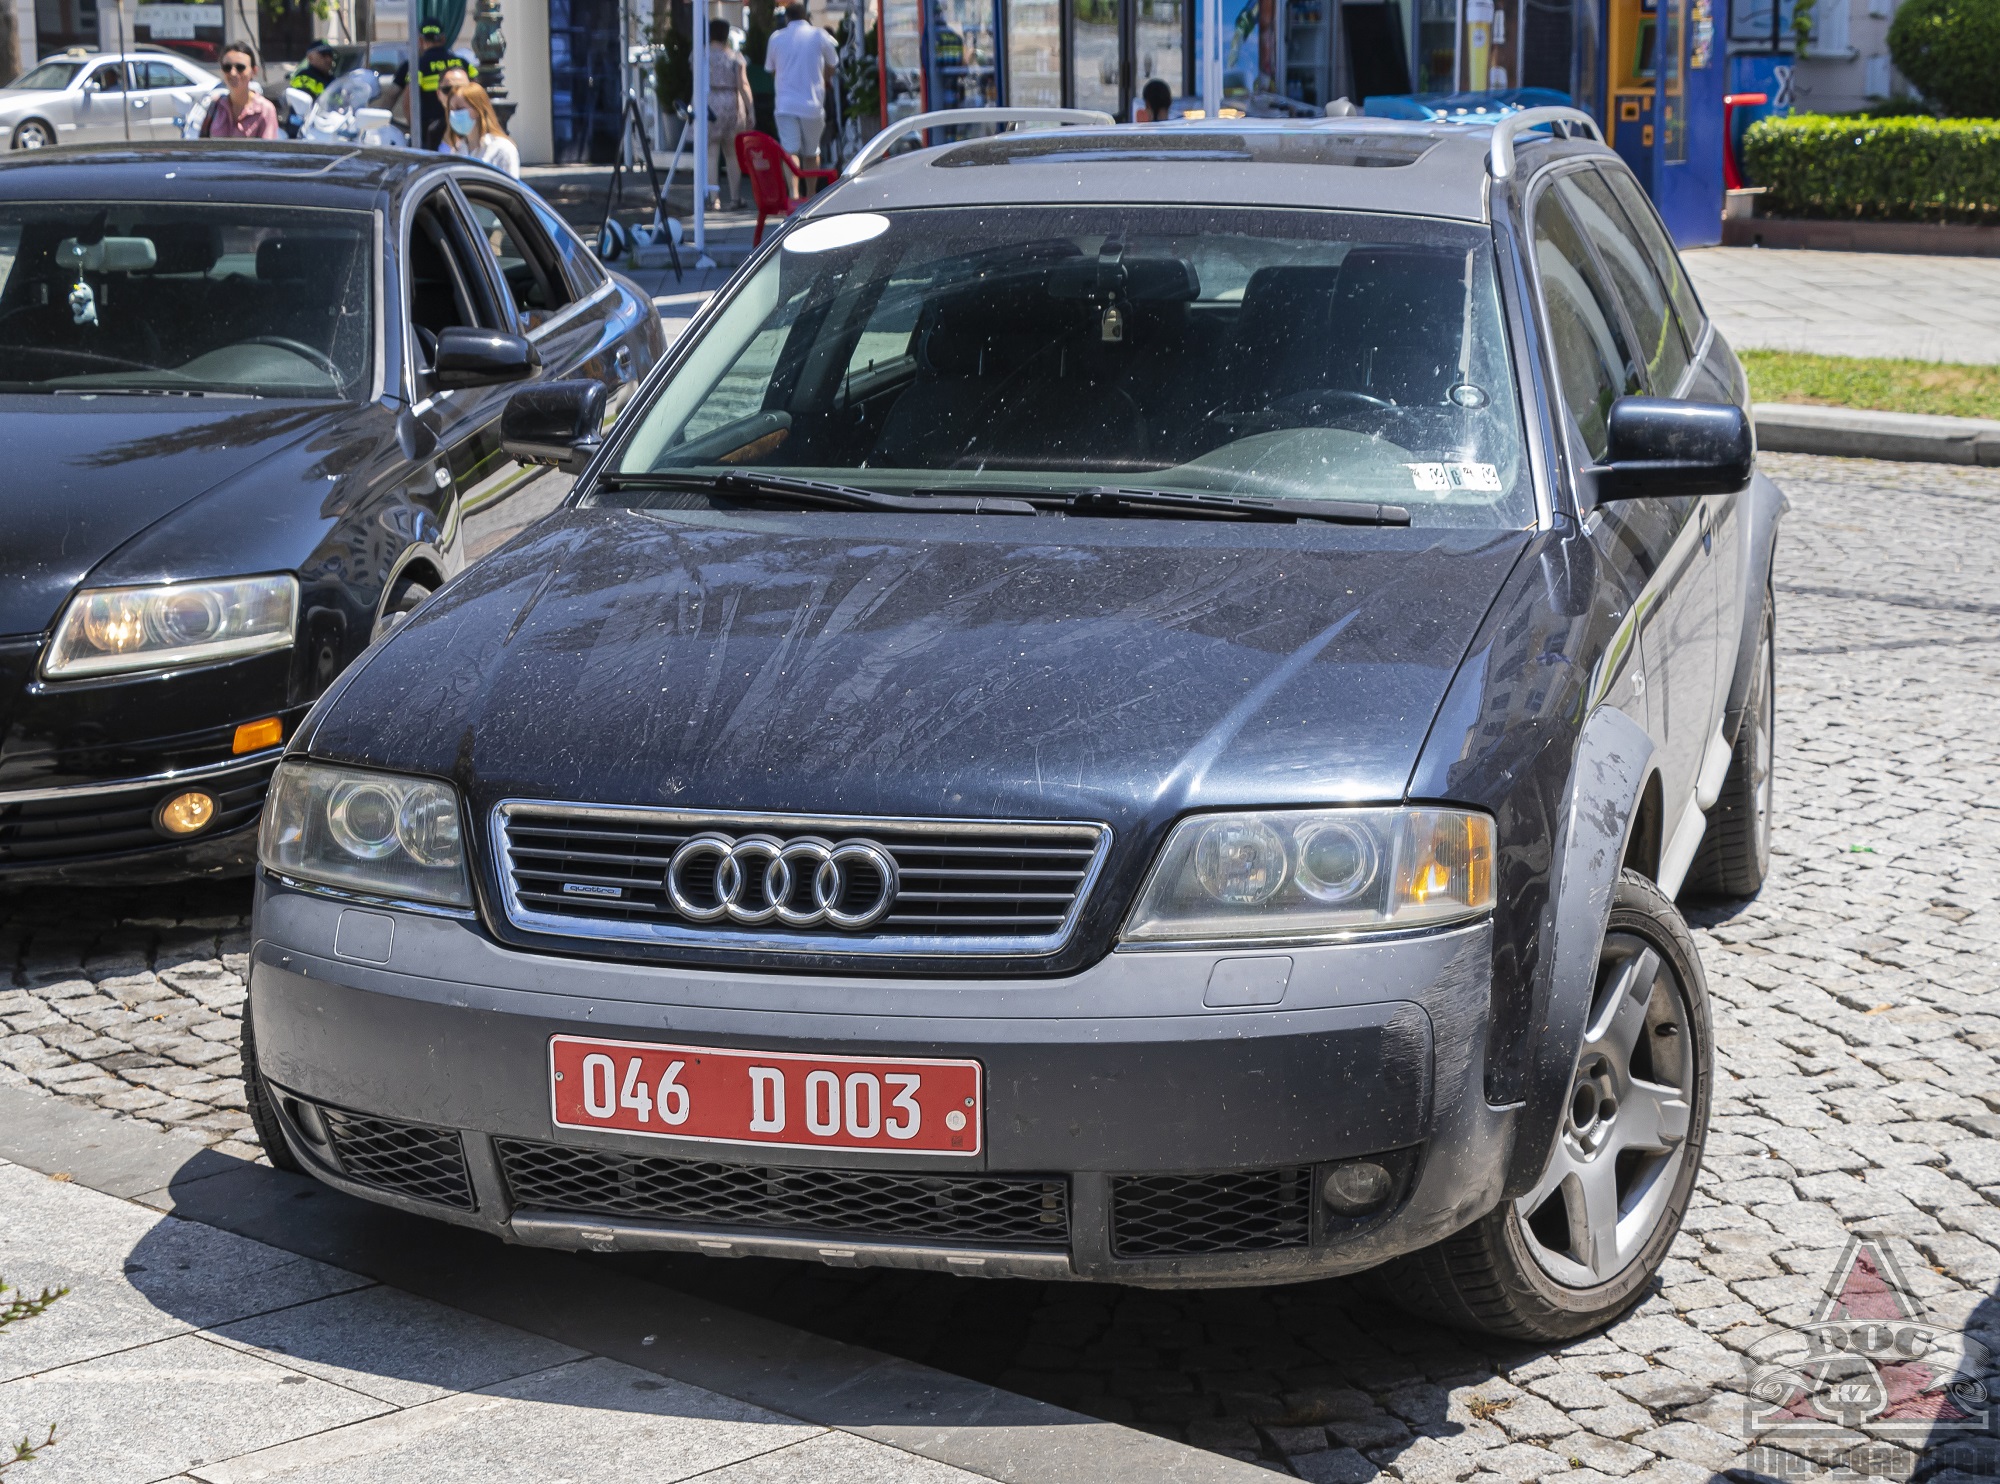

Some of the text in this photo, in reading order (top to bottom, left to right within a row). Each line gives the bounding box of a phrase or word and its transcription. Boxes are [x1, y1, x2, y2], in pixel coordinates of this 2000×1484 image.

[569, 885, 615, 894] quattro
[582, 1053, 922, 1140] 046 D 003
